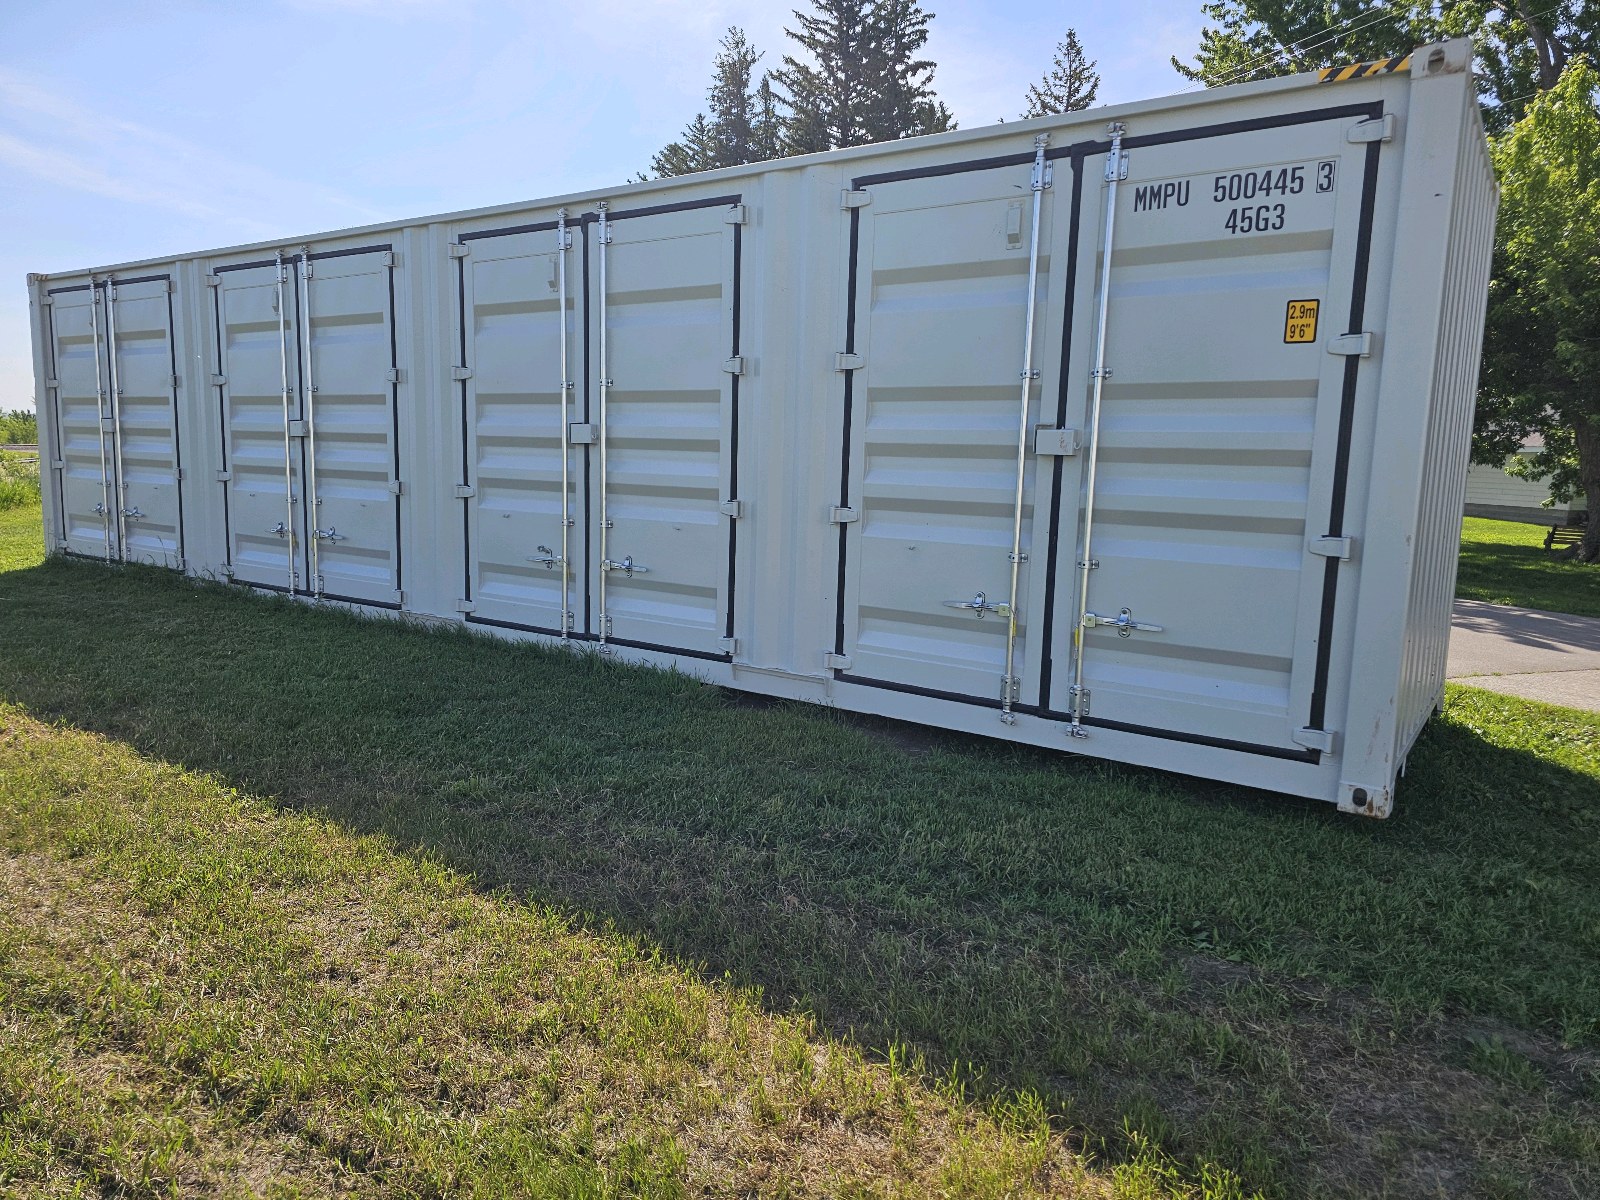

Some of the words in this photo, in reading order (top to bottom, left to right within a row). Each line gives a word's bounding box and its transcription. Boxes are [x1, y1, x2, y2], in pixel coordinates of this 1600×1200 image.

[1133, 180, 1190, 212] MMPU
[1213, 166, 1305, 202] 500445
[1318, 162, 1334, 191] 3
[1224, 203, 1286, 234] 45G3
[1289, 304, 1315, 319] 2.9m
[1289, 323, 1311, 339] 9'6"
